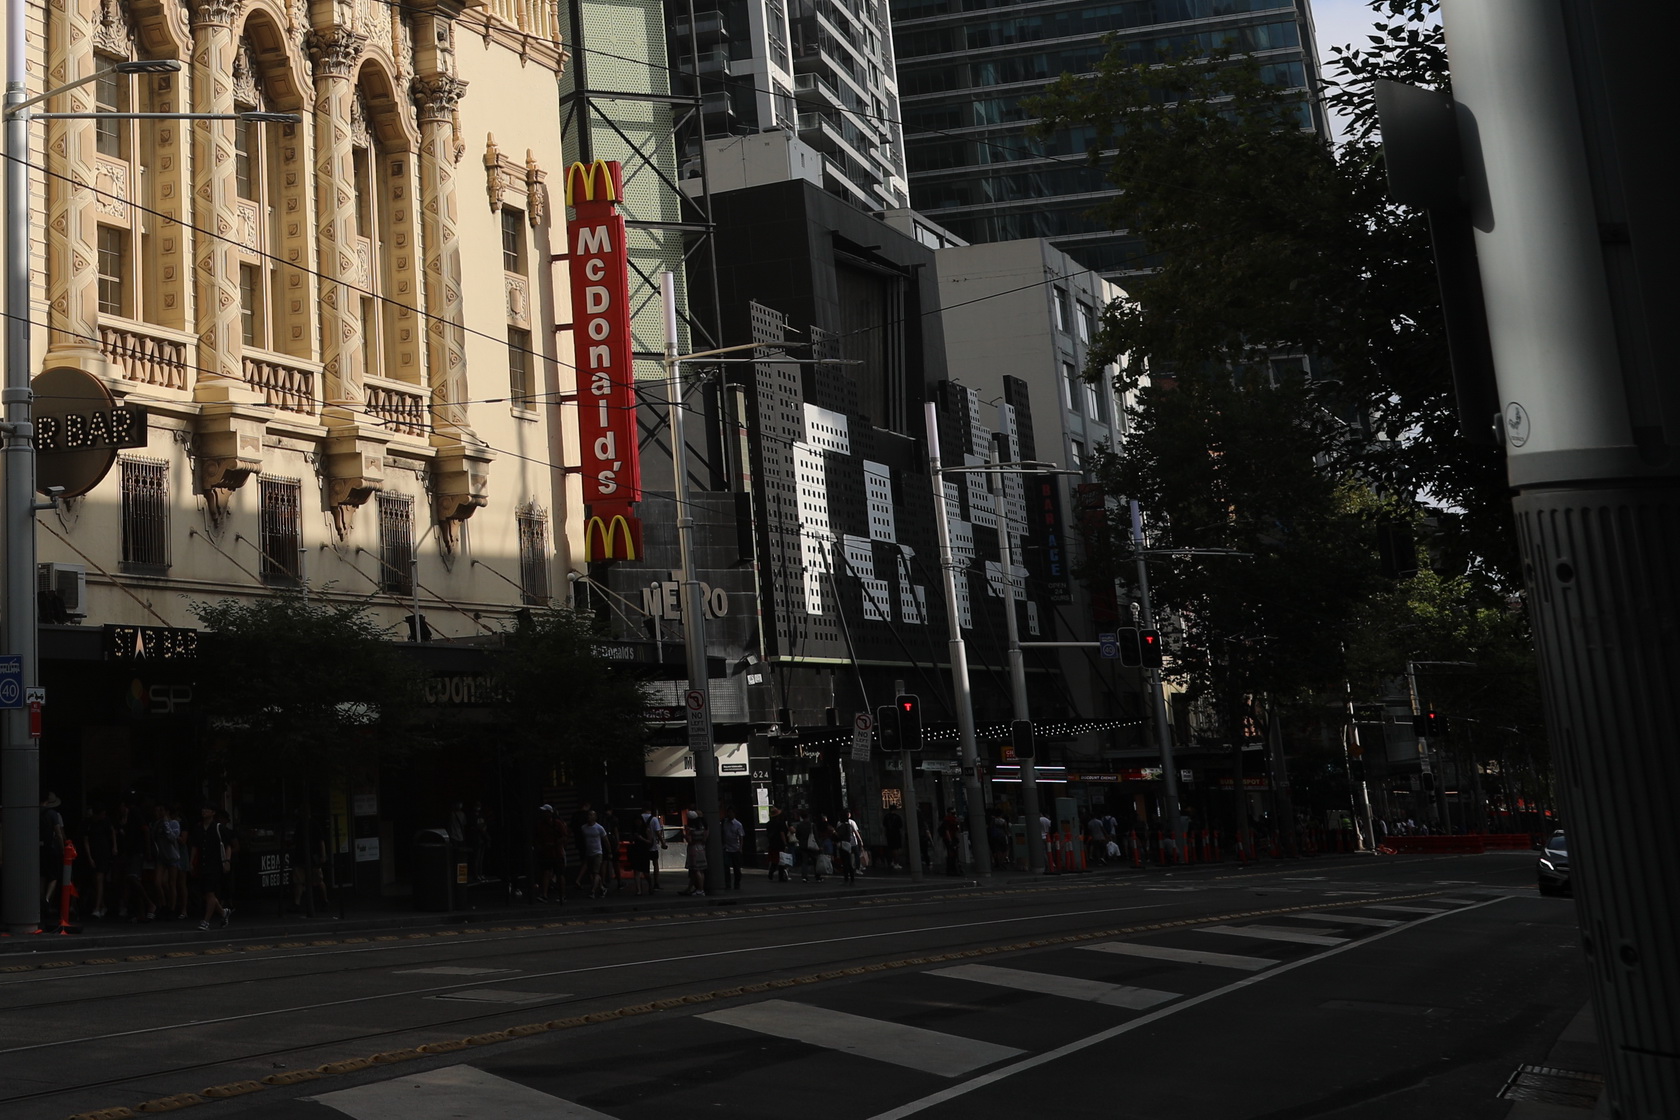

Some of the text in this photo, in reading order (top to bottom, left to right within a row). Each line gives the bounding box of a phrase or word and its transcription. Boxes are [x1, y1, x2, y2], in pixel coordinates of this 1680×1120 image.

[576, 225, 622, 496] McDonald's
[64, 408, 136, 449] BAR
[115, 627, 198, 660] STAR BAR
[1, 684, 16, 698] 40
[691, 712, 703, 720] NO
[752, 770, 770, 779] 624
[261, 853, 290, 870] KEBAS
